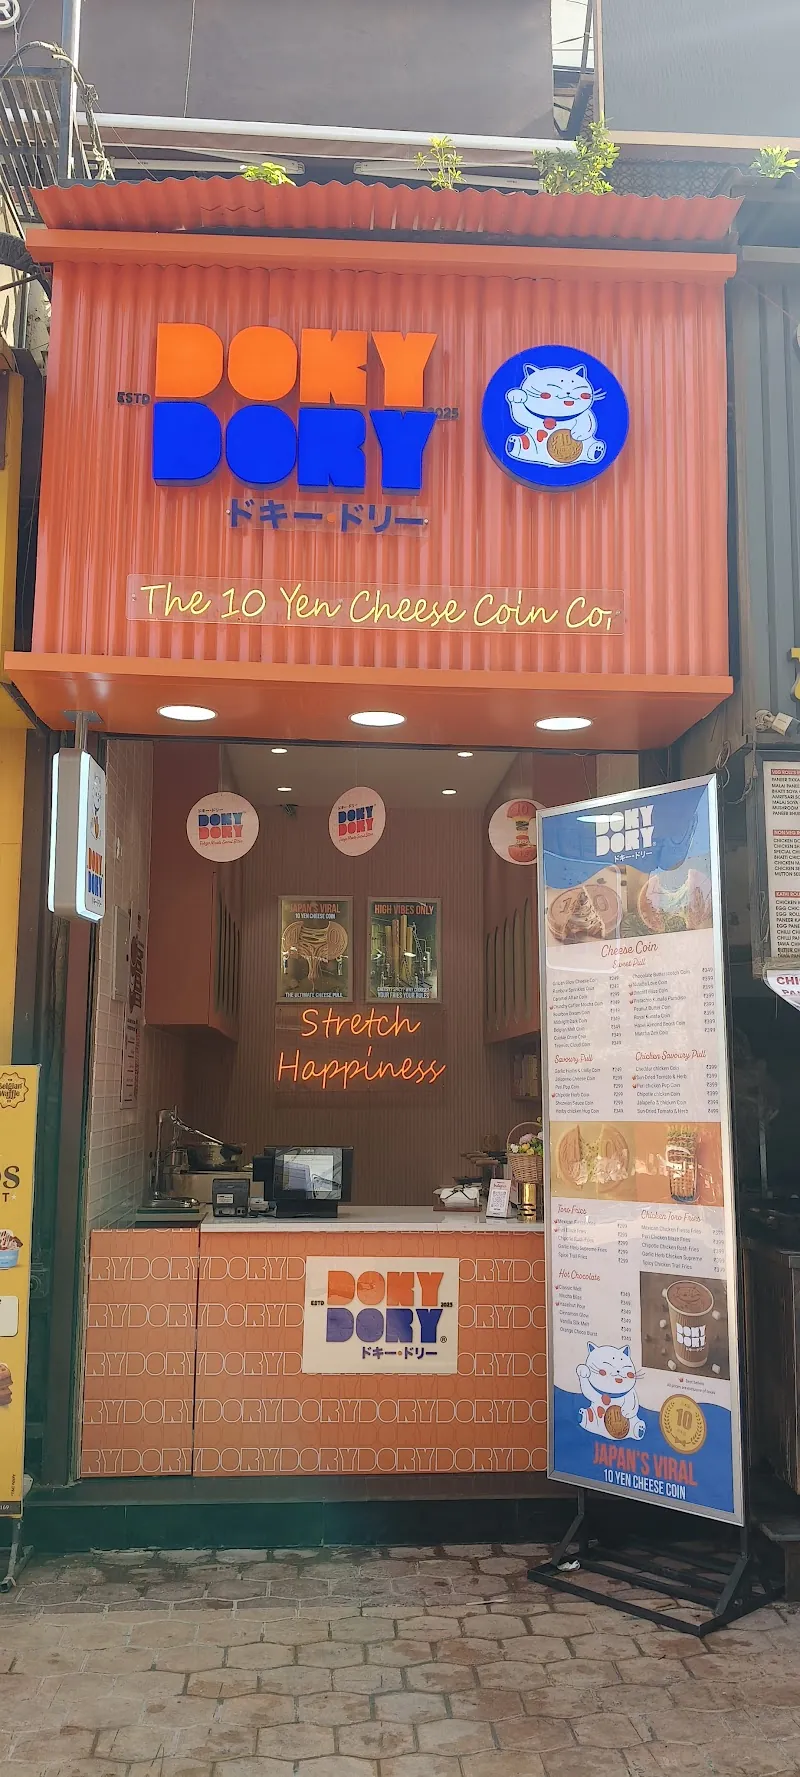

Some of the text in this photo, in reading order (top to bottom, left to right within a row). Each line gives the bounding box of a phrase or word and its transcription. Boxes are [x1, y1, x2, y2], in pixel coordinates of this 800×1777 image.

[155, 322, 438, 407] DOKY
[117, 391, 150, 405] ESTD
[153, 401, 438, 491] DORY
[140, 581, 211, 617] The
[221, 588, 266, 618] 10
[280, 583, 341, 621] Yen
[350, 590, 466, 627] Cheese
[473, 590, 558, 627] Coin
[198, 812, 243, 826] DOKY
[338, 805, 374, 823] DOKY
[595, 804, 654, 836] DOKY
[198, 825, 244, 840] DORY
[338, 817, 374, 836] DORY
[595, 826, 654, 856] DORY
[320, 904, 340, 913] VIRAL
[374, 903, 434, 915] HIGH VIBES ONLY
[601, 941, 659, 958] Cheese Coin
[301, 1005, 421, 1038] Stretch
[554, 1053, 593, 1064] Savoury Pull
[635, 1049, 707, 1061] Chicken Savoury Pull
[277, 1045, 446, 1089] Happiness
[640, 1209, 701, 1223] Chicken Toro Fries
[559, 1268, 600, 1281] Hot Chocolate
[327, 1270, 444, 1306] DOKY
[326, 1307, 443, 1343] DORY
[676, 1408, 693, 1430] 10
[593, 1440, 698, 1487] JAPAN'S VIRAL
[603, 1468, 686, 1500] 10 YEN CHEESE COIN
